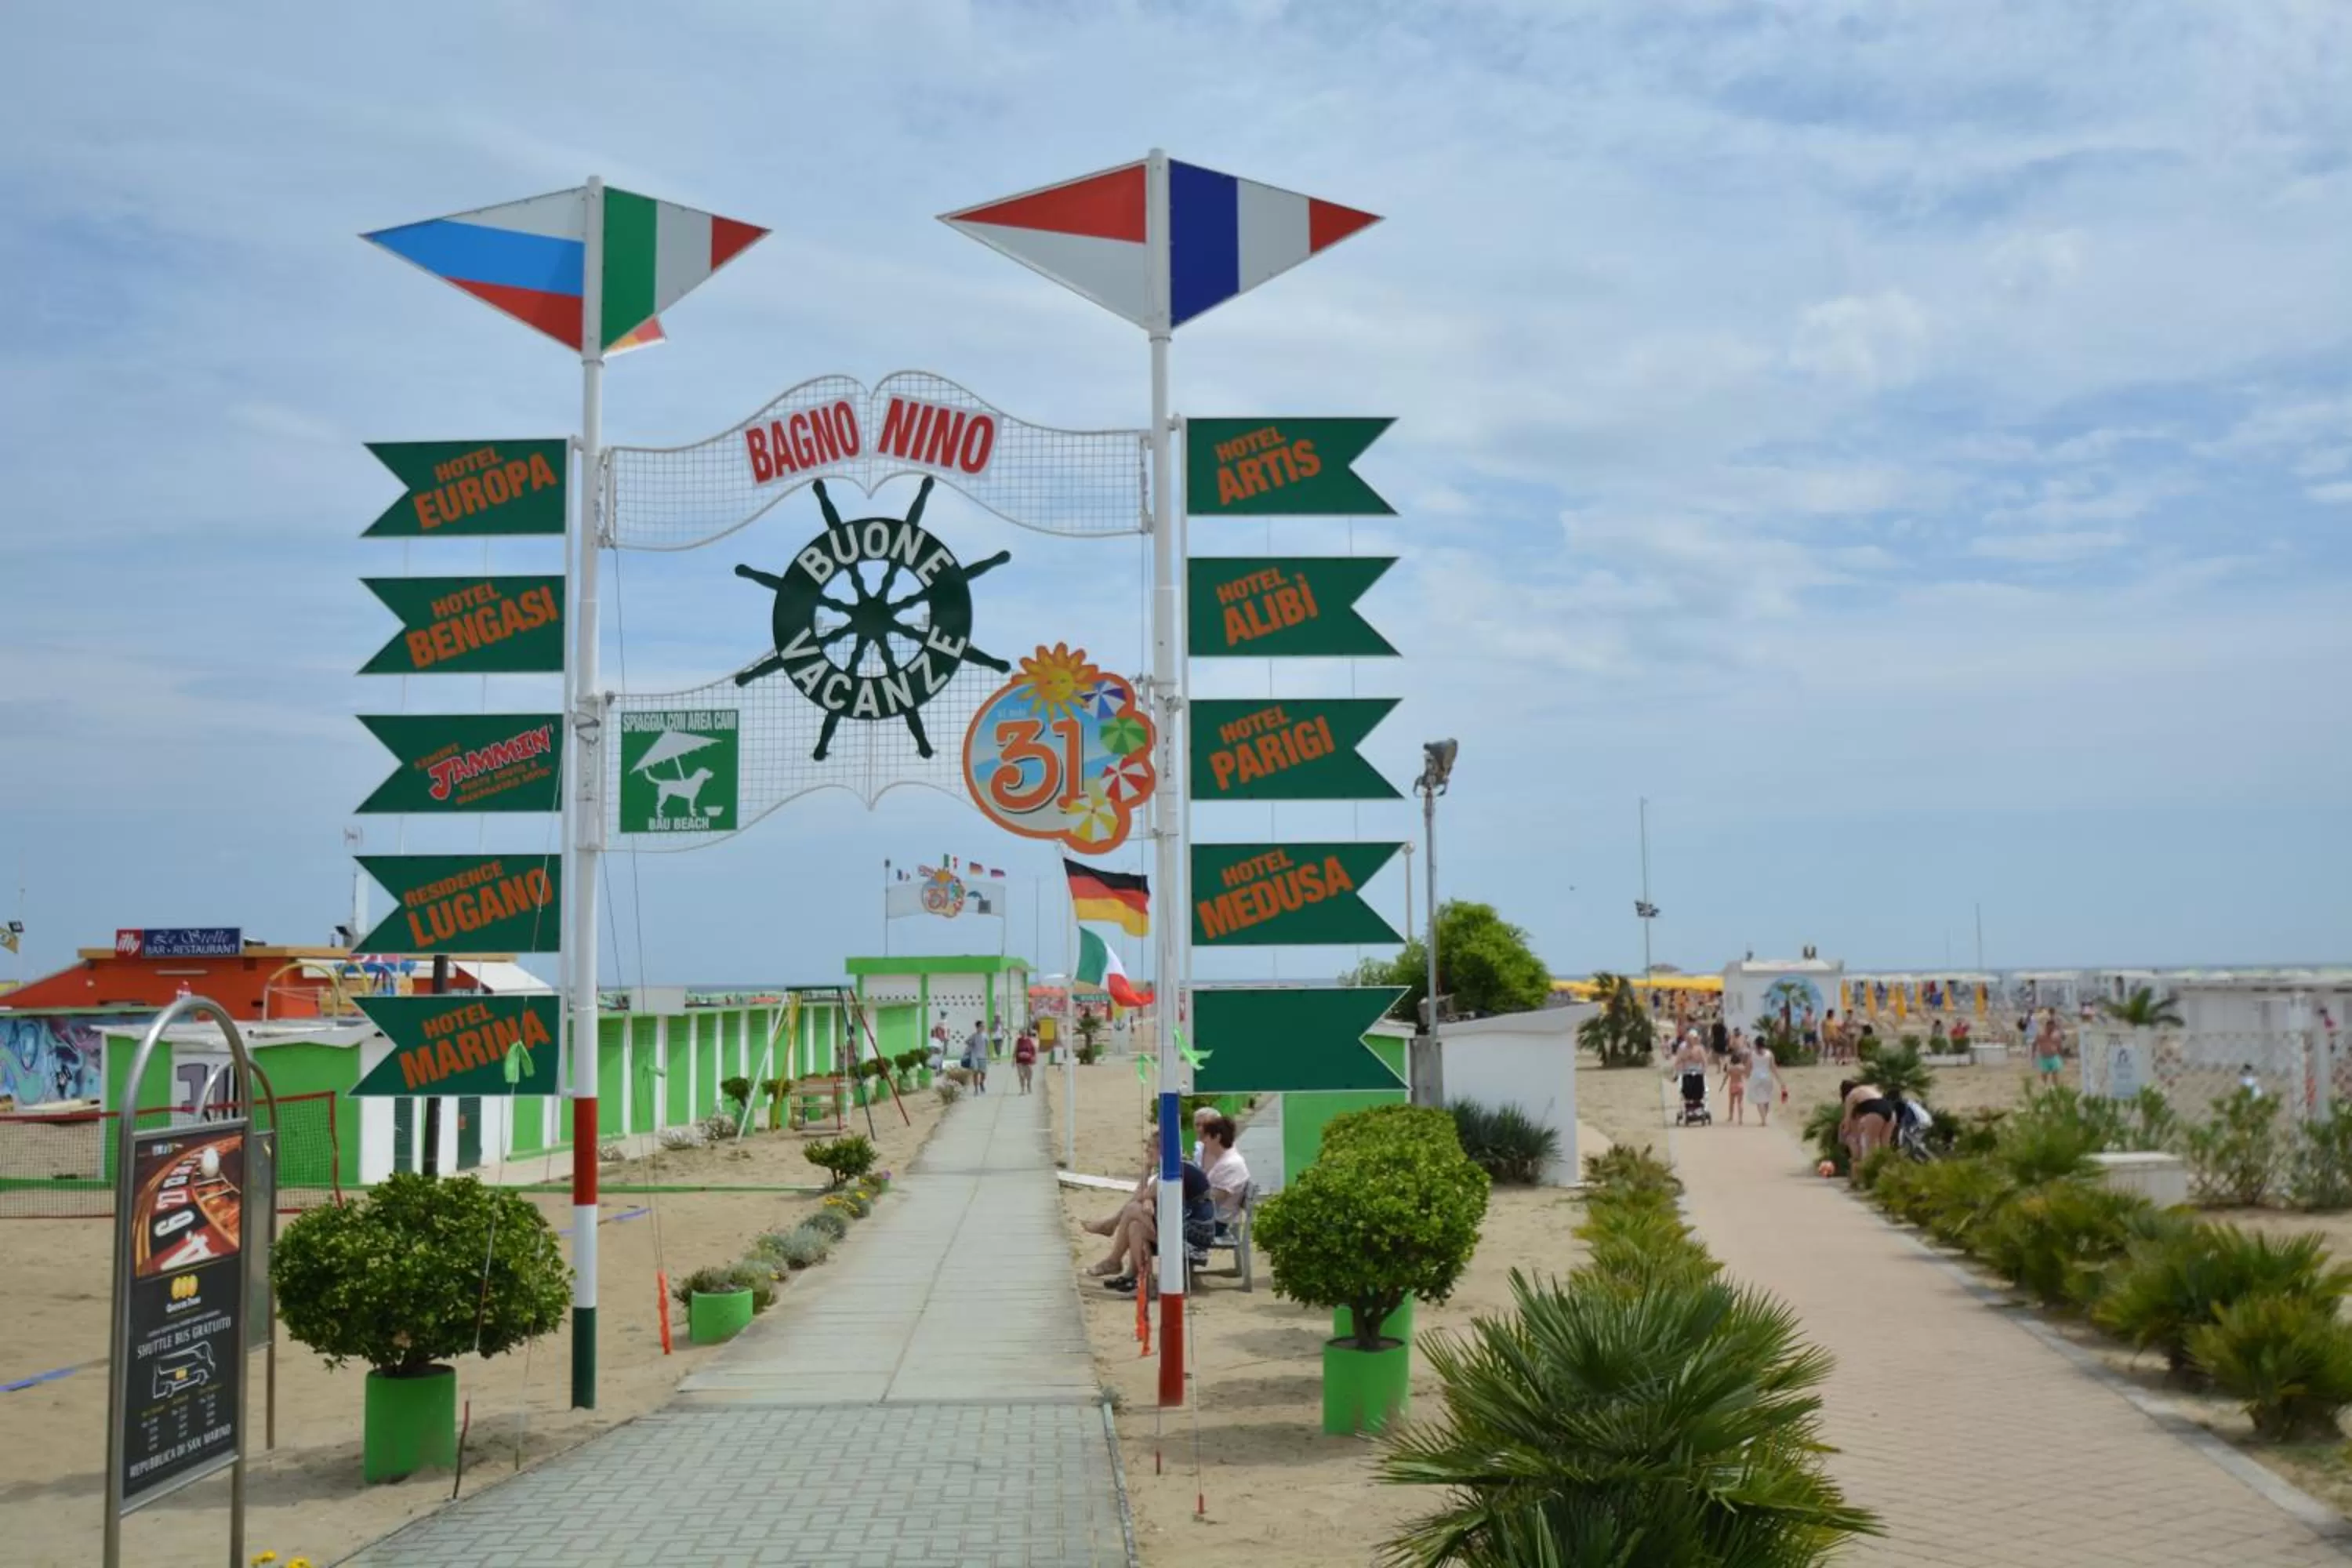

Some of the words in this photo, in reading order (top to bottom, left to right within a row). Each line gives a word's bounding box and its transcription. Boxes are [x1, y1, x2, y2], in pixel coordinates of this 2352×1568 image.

[746, 401, 860, 484] BAGNO
[878, 397, 994, 474] NINO
[1216, 426, 1286, 463] HOTEL
[434, 446, 503, 483] HOTEL
[1218, 439, 1321, 506] ARTIS
[413, 452, 557, 529] EUROPA
[797, 521, 955, 587] BUONE
[431, 582, 503, 619] HOTEL
[1217, 568, 1288, 604] HOTEL
[405, 586, 558, 668] BENGASI
[780, 625, 967, 718] VACANZE
[623, 713, 665, 732] SPIAGGIA
[668, 713, 686, 731] CON
[688, 713, 713, 731] AREA
[714, 712, 736, 730] CANI
[1220, 704, 1290, 743] HOTEL
[991, 717, 1088, 814] 31
[1209, 715, 1335, 790] PARIGI
[648, 817, 670, 830] BAU
[673, 816, 710, 829] BEACH
[405, 860, 503, 907] RESIDENCE
[1221, 848, 1294, 887] HOTEL
[407, 868, 553, 948] LUGANO
[1197, 855, 1353, 939] MEDUSA
[118, 932, 140, 956] illy
[145, 944, 164, 954] BAR
[172, 944, 236, 954] RESTAURANT
[422, 1003, 494, 1039] HOTEL
[398, 1009, 551, 1090] MARINA
[137, 1334, 172, 1360] SHUTTLE
[175, 1329, 191, 1345] BUS
[192, 1316, 231, 1339] GRATUITO
